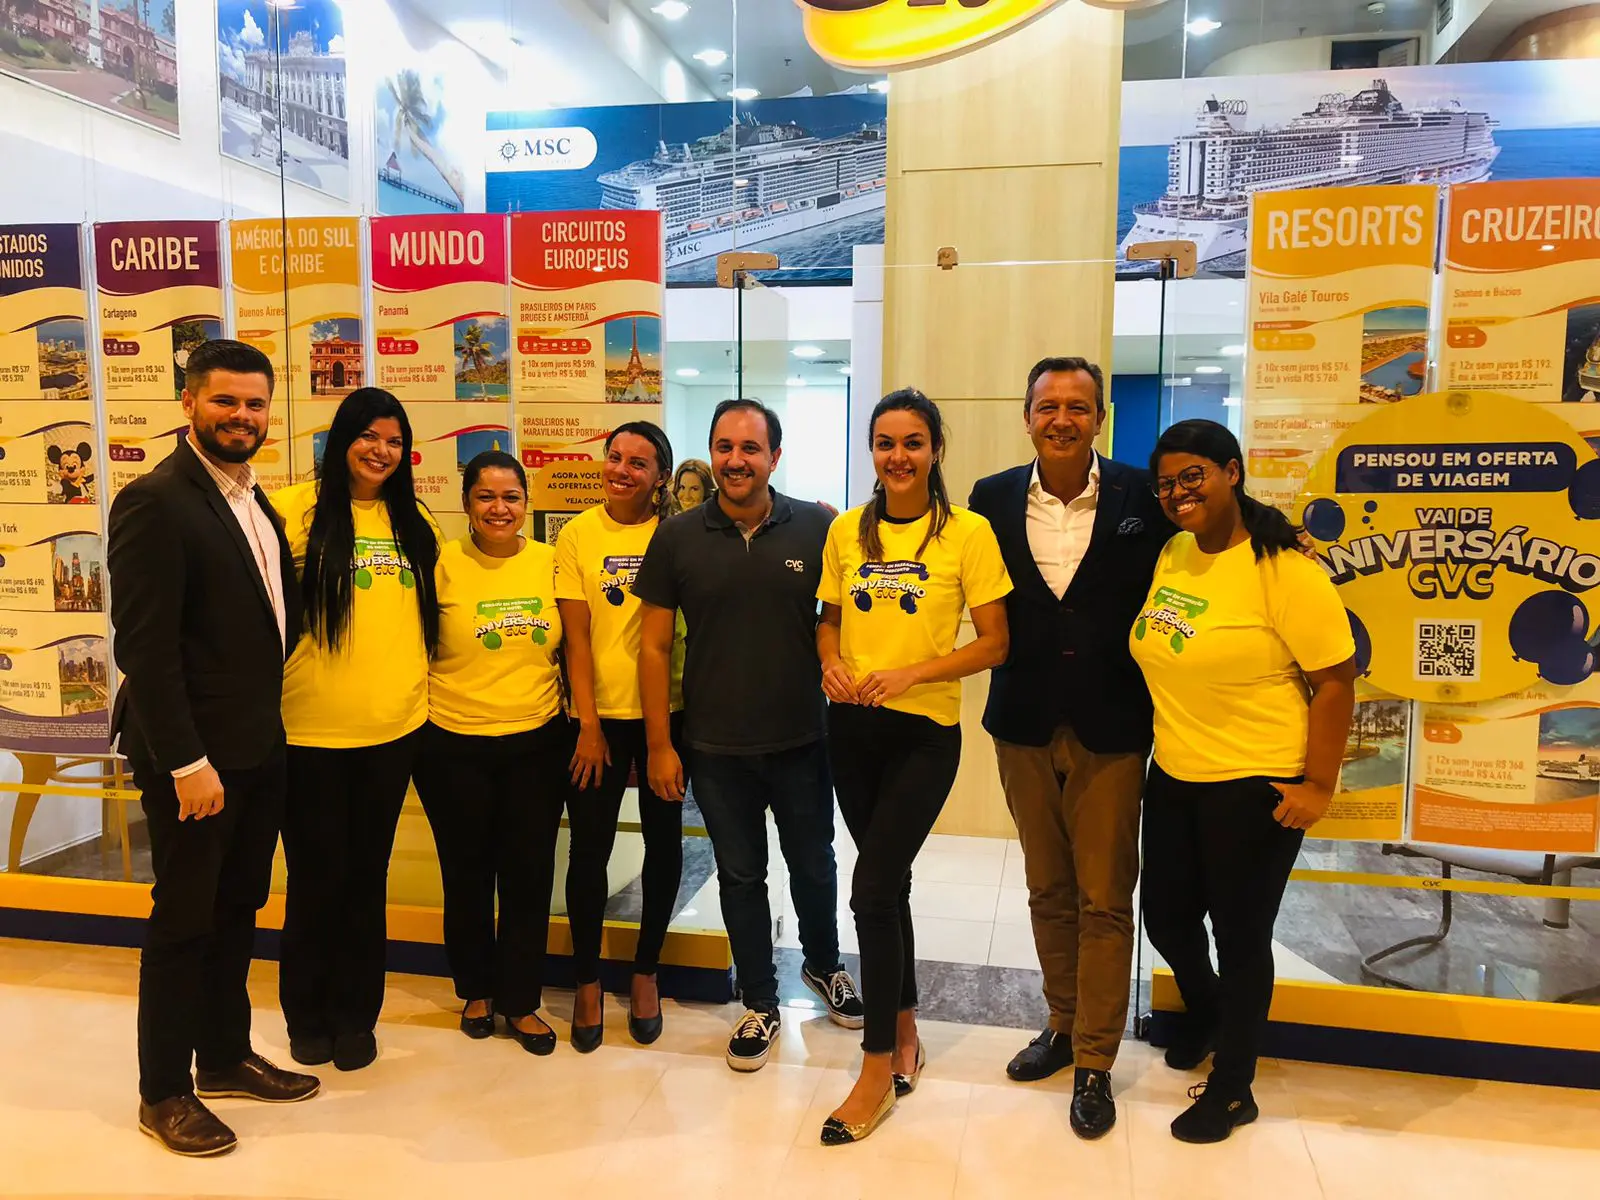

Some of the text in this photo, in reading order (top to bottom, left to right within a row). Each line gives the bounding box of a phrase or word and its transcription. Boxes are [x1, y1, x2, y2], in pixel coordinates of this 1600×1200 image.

[524, 138, 571, 156] MSC
[541, 220, 626, 243] CIRCUITOS
[1267, 204, 1424, 250] RESORTS
[236, 224, 354, 250] AMÉRICA DO SUL
[110, 236, 200, 271] CARIBE
[389, 230, 485, 267] MUNDO
[677, 241, 701, 257] MSC
[259, 253, 325, 275] E CARIBE
[544, 248, 629, 270] EUROPEUS
[0, 259, 44, 279] NIDOS
[1259, 290, 1350, 304] Vila Galé Touros
[239, 305, 287, 317] Buenos Aires
[378, 304, 409, 316] Panamá
[520, 302, 596, 312] BRASILEIROS EM PARIS
[103, 308, 137, 320] Cartagena
[520, 311, 589, 322] BRUGES E AMSTERDÃ
[528, 360, 539, 368] 10x
[555, 360, 571, 369] juros
[1299, 362, 1319, 373] juros
[1322, 362, 1332, 371] R$
[1476, 361, 1494, 369] sem
[1496, 360, 1519, 371] juros
[1521, 359, 1533, 369] R$
[1303, 373, 1315, 382] R$
[1501, 371, 1513, 381] R$
[109, 414, 147, 425] Punta Cana
[523, 417, 580, 426] BRASILEIROS NAS
[523, 428, 564, 436] MARAVILHAS
[565, 428, 574, 437] DE
[1353, 451, 1558, 467] PENSOU EM OFERTA
[579, 471, 600, 479] VOCÊ
[1396, 472, 1510, 487] DE VIAGEM
[558, 482, 592, 490] OFERTAS
[565, 497, 606, 505] VEJA COMO
[1416, 508, 1492, 525] VAI DE
[2, 523, 18, 533] York
[785, 559, 804, 568] CVC
[375, 565, 396, 576] CVC
[1408, 563, 1494, 598] CVC
[875, 588, 897, 599] CVC
[0, 627, 18, 638] icago
[504, 624, 527, 637] CVC
[1450, 759, 1470, 767] sem
[1471, 759, 1494, 770] juros
[1495, 759, 1507, 770] R$
[1476, 769, 1488, 780] R$
[1421, 879, 1441, 887] CVC
